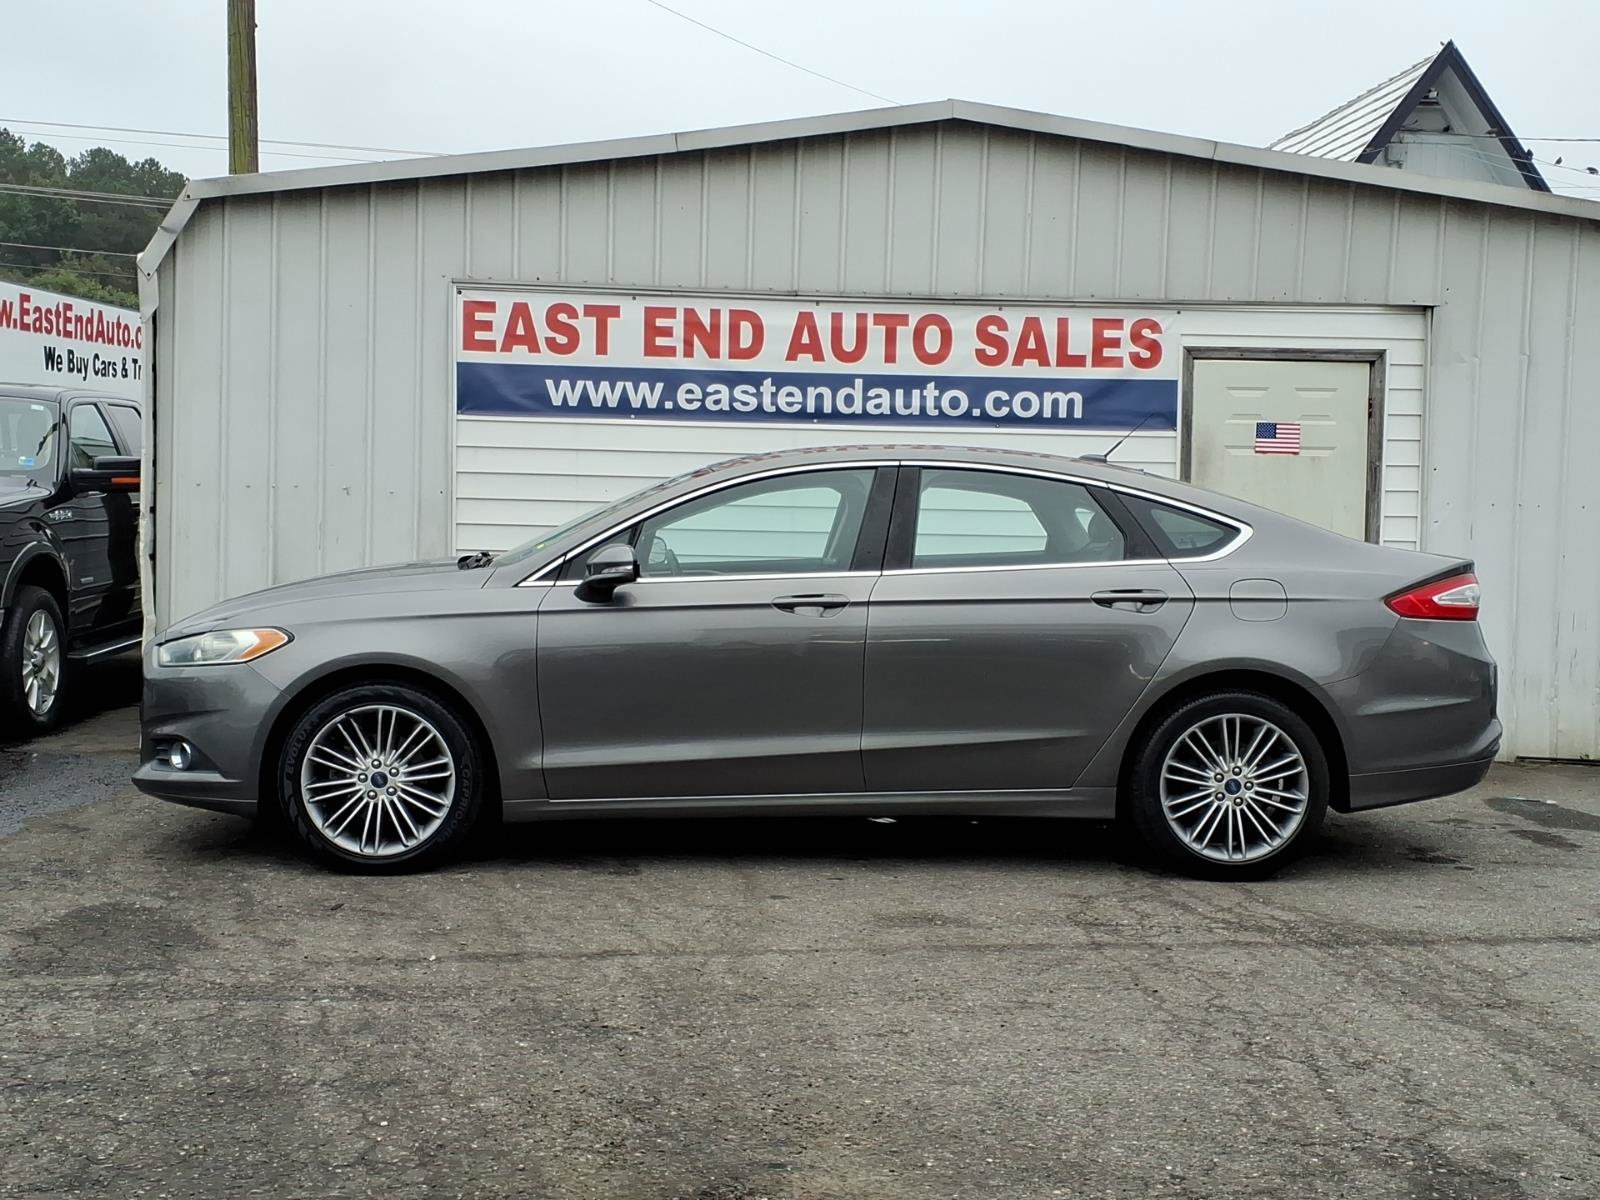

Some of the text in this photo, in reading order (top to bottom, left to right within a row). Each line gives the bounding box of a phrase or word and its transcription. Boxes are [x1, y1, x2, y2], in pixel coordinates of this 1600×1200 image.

[462, 300, 1164, 370] EAST END AUTO SALES
[44, 345, 63, 372] We
[66, 348, 89, 381] Buy
[92, 352, 118, 378] Cars
[120, 356, 129, 379] &
[545, 377, 1083, 420] www.eastendauto.com
